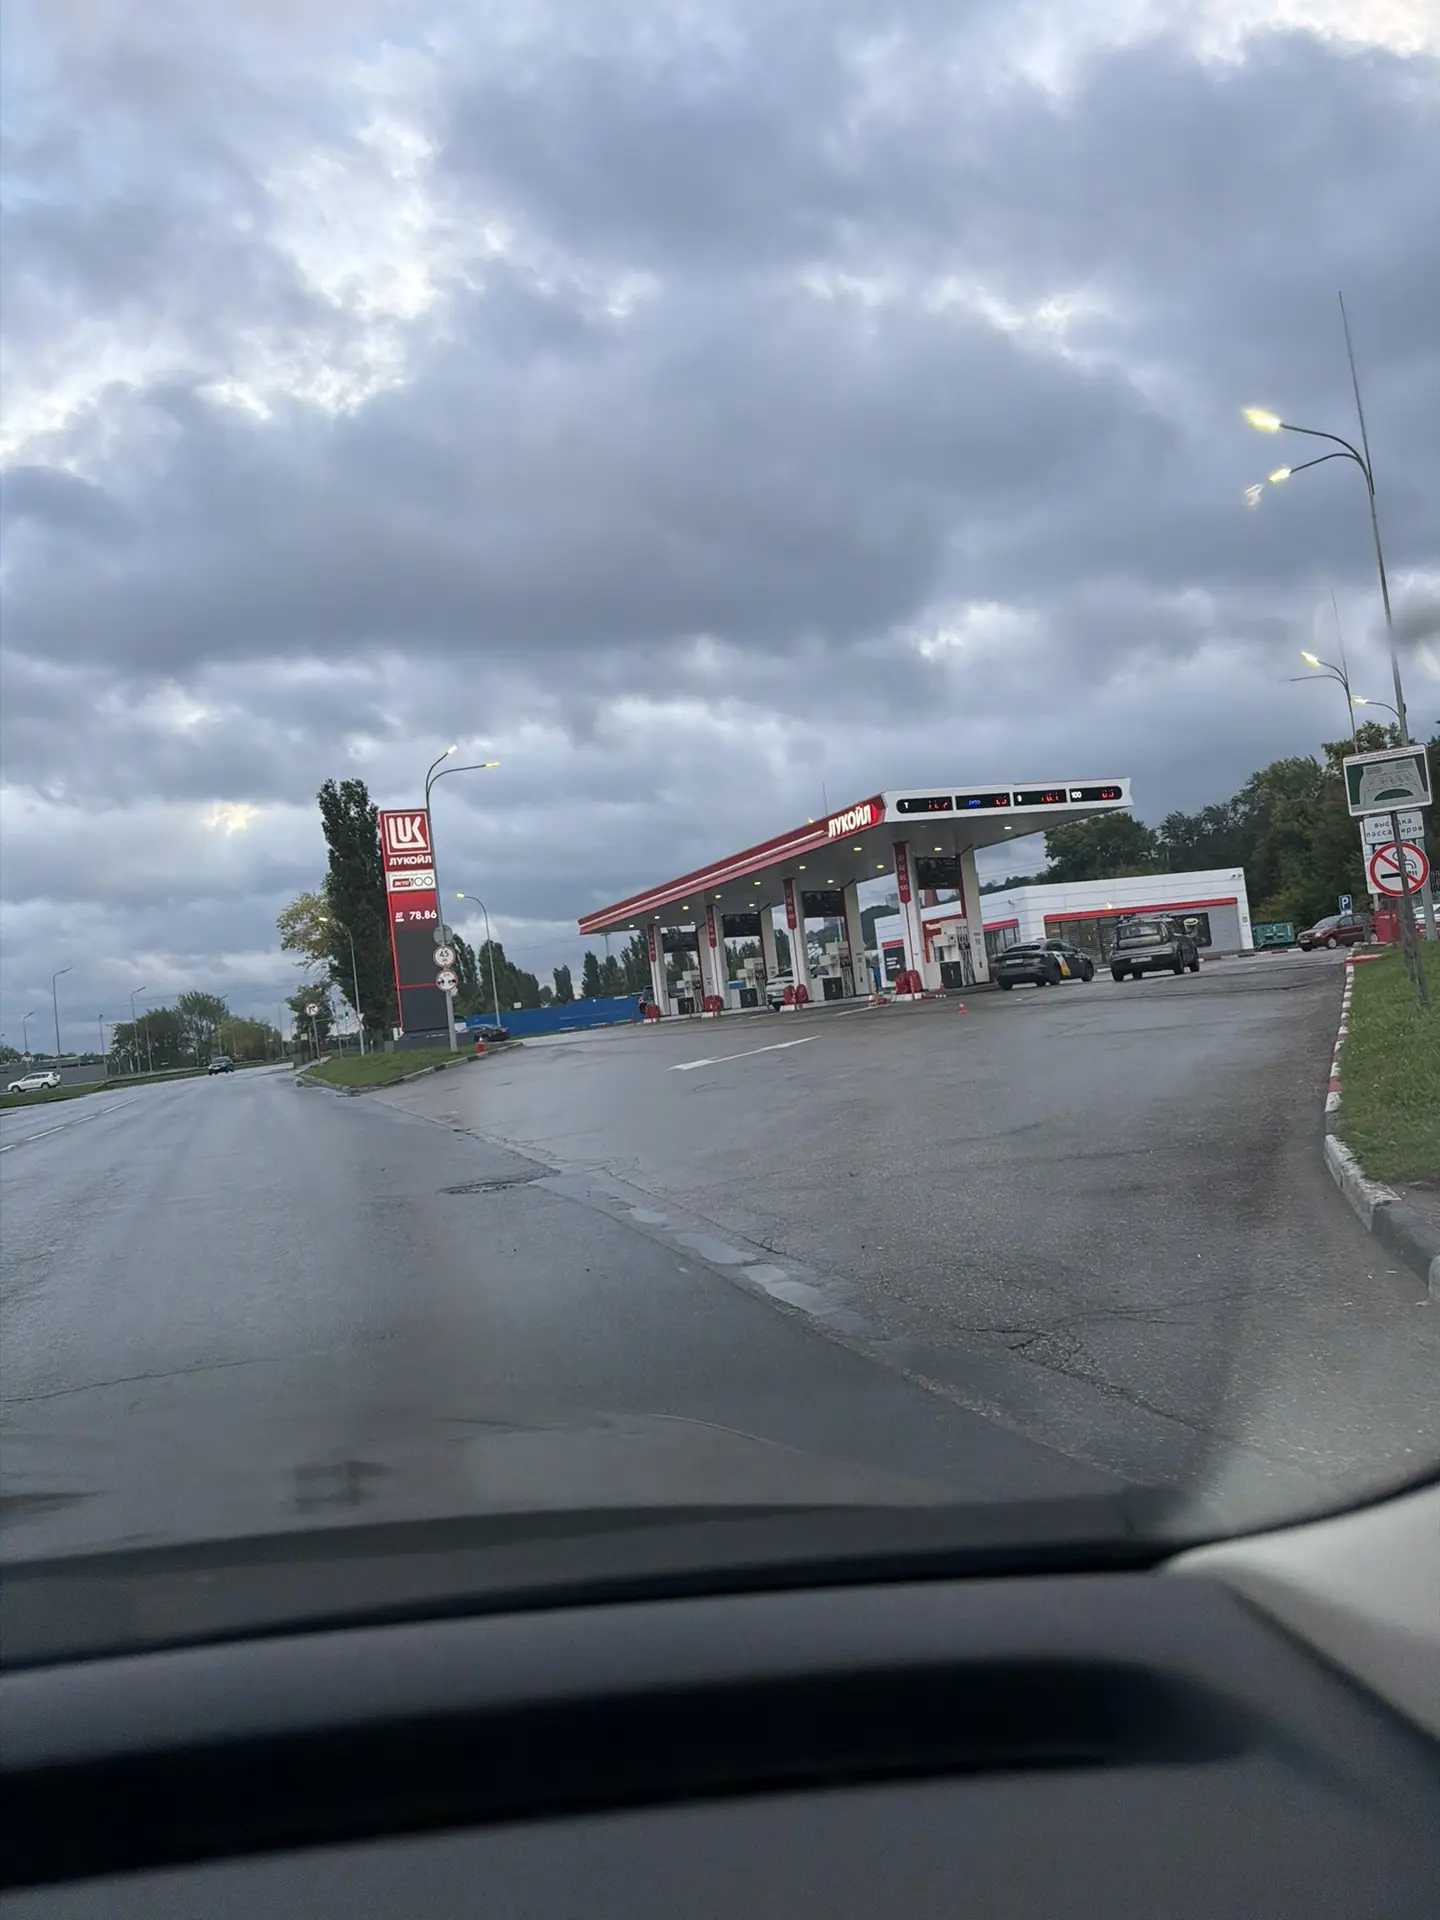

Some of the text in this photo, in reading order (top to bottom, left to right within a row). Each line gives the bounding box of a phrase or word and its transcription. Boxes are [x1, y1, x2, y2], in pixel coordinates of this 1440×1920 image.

[828, 803, 872, 838] ЛУКОЙЛ
[1366, 825, 1423, 838] пассаиров
[389, 854, 432, 866] ЛУКОЙЛ
[1341, 897, 1349, 909] P
[409, 910, 437, 920] 78.86
